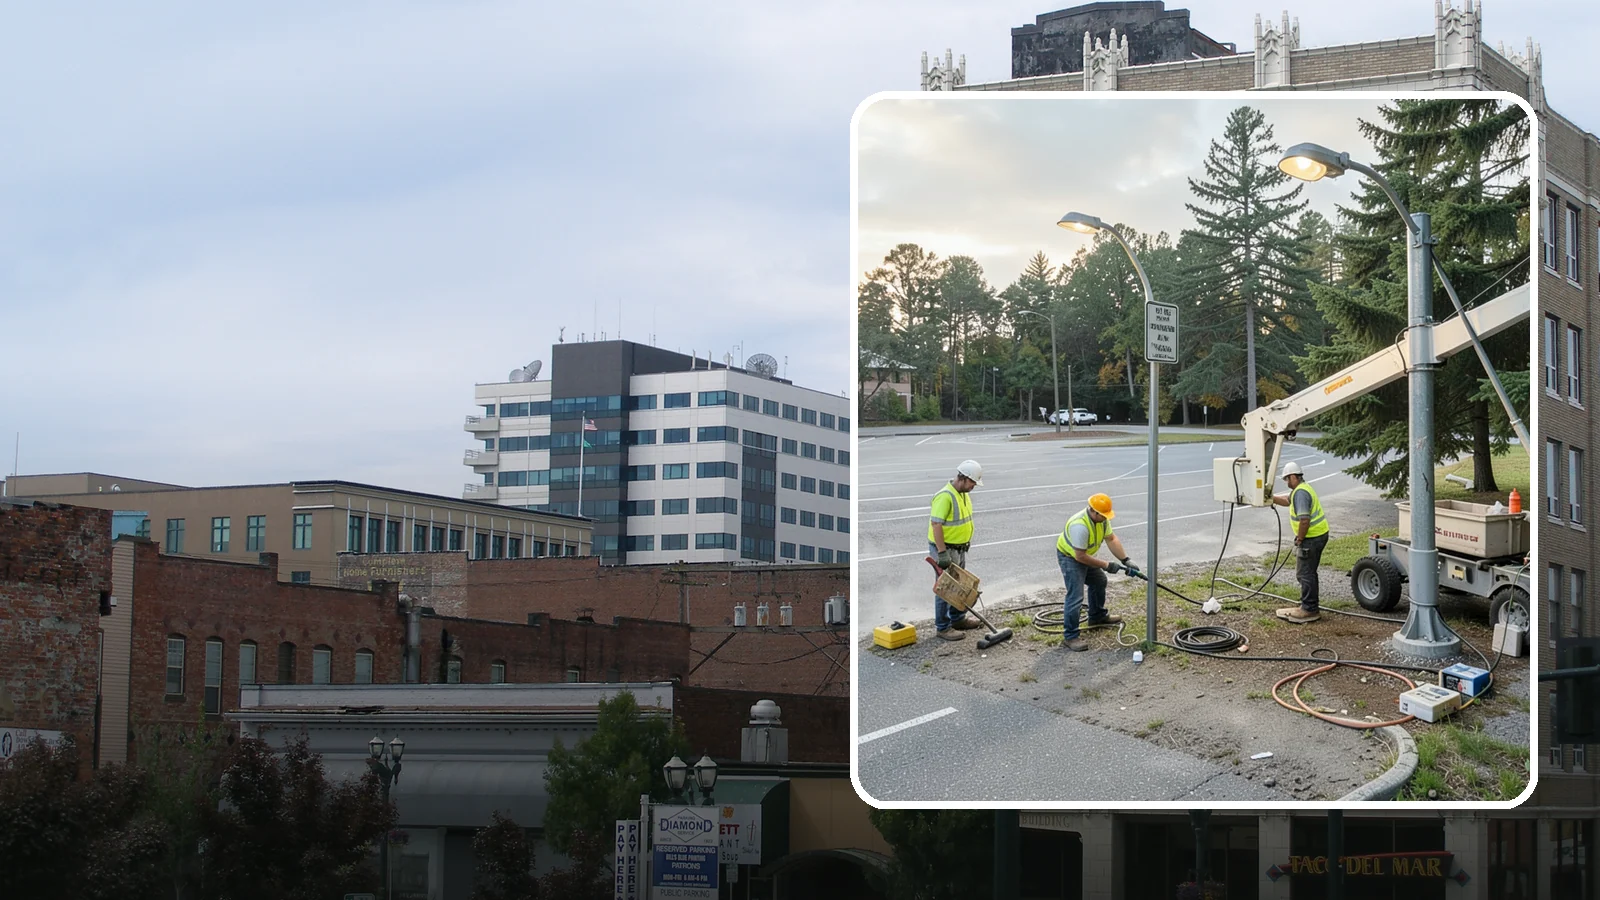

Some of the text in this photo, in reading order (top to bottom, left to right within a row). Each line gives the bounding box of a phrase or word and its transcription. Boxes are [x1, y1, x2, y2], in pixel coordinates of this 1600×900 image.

[660, 818, 713, 832] DIAMOND
[1021, 815, 1070, 828] BUILDING
[655, 845, 716, 854] RESERVED PARKING
[616, 825, 625, 894] PAY HERE
[628, 825, 637, 893] PAY HERE
[671, 862, 701, 870] PATRONS
[1345, 856, 1385, 876] DEL
[1392, 857, 1442, 877] MAR
[660, 888, 710, 898] PUBLIC PARKING
